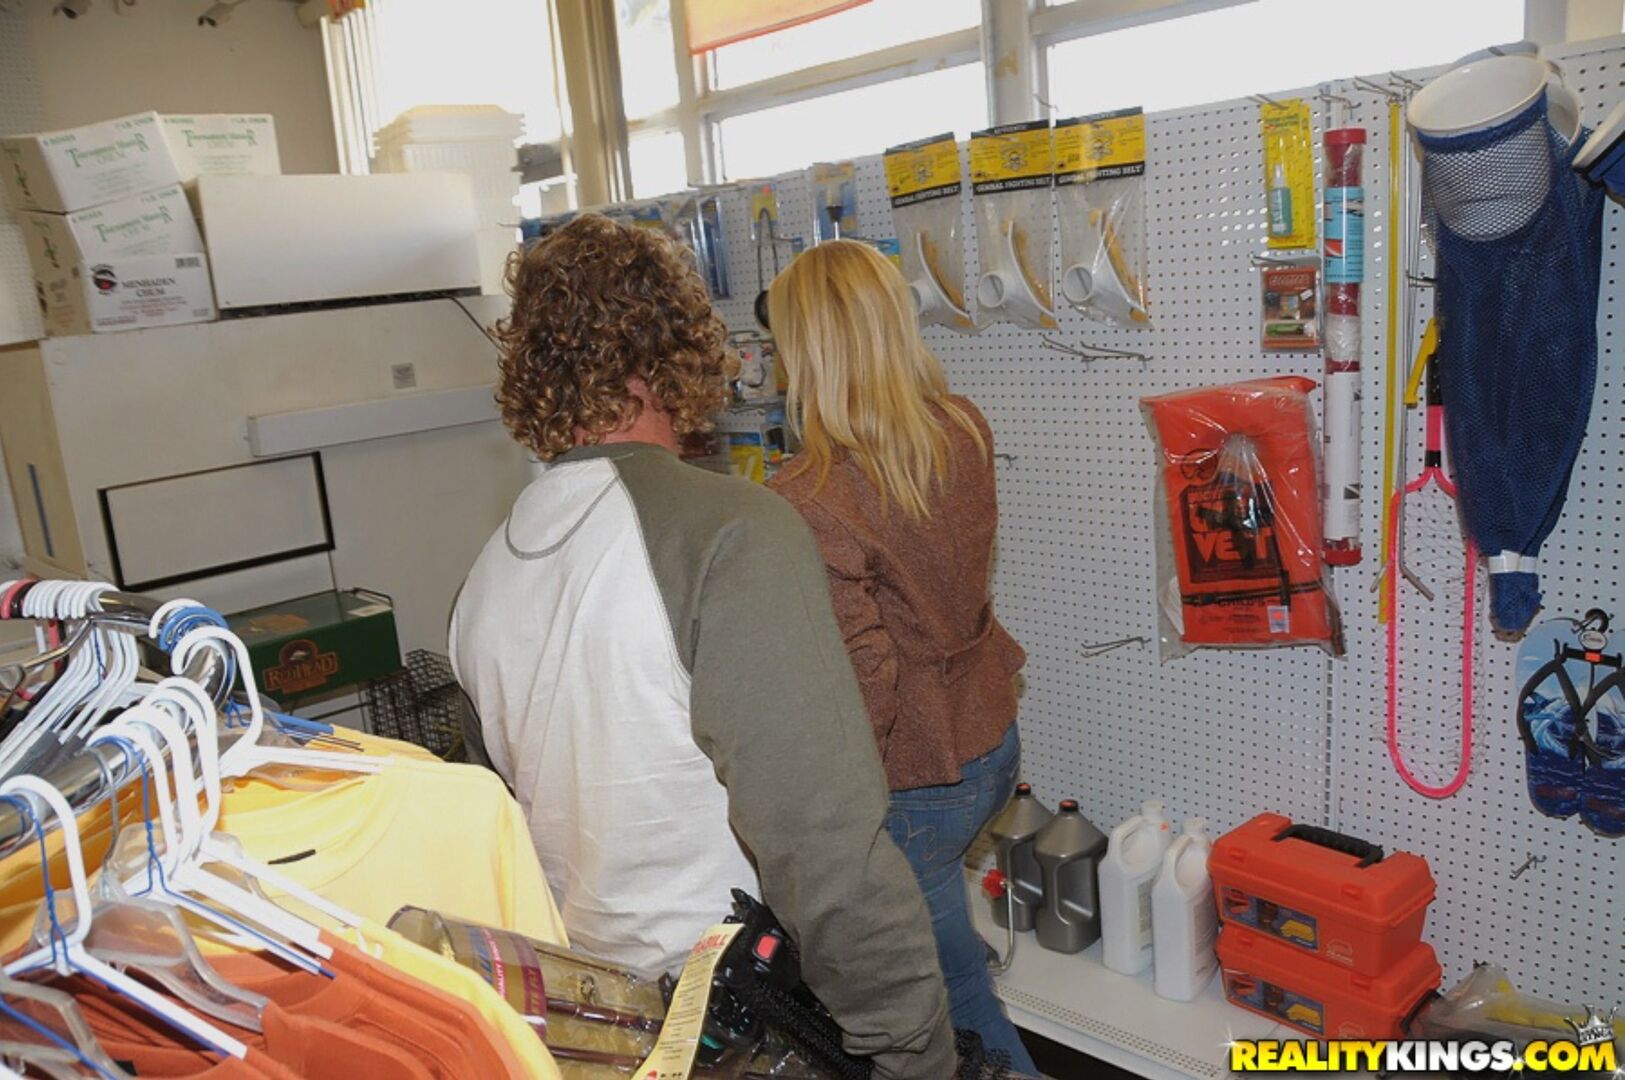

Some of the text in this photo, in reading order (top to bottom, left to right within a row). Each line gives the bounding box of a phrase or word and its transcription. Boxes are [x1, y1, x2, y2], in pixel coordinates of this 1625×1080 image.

[1122, 165, 1142, 177] BELT
[121, 277, 176, 289] MENHADEN
[1192, 529, 1273, 563] VET
